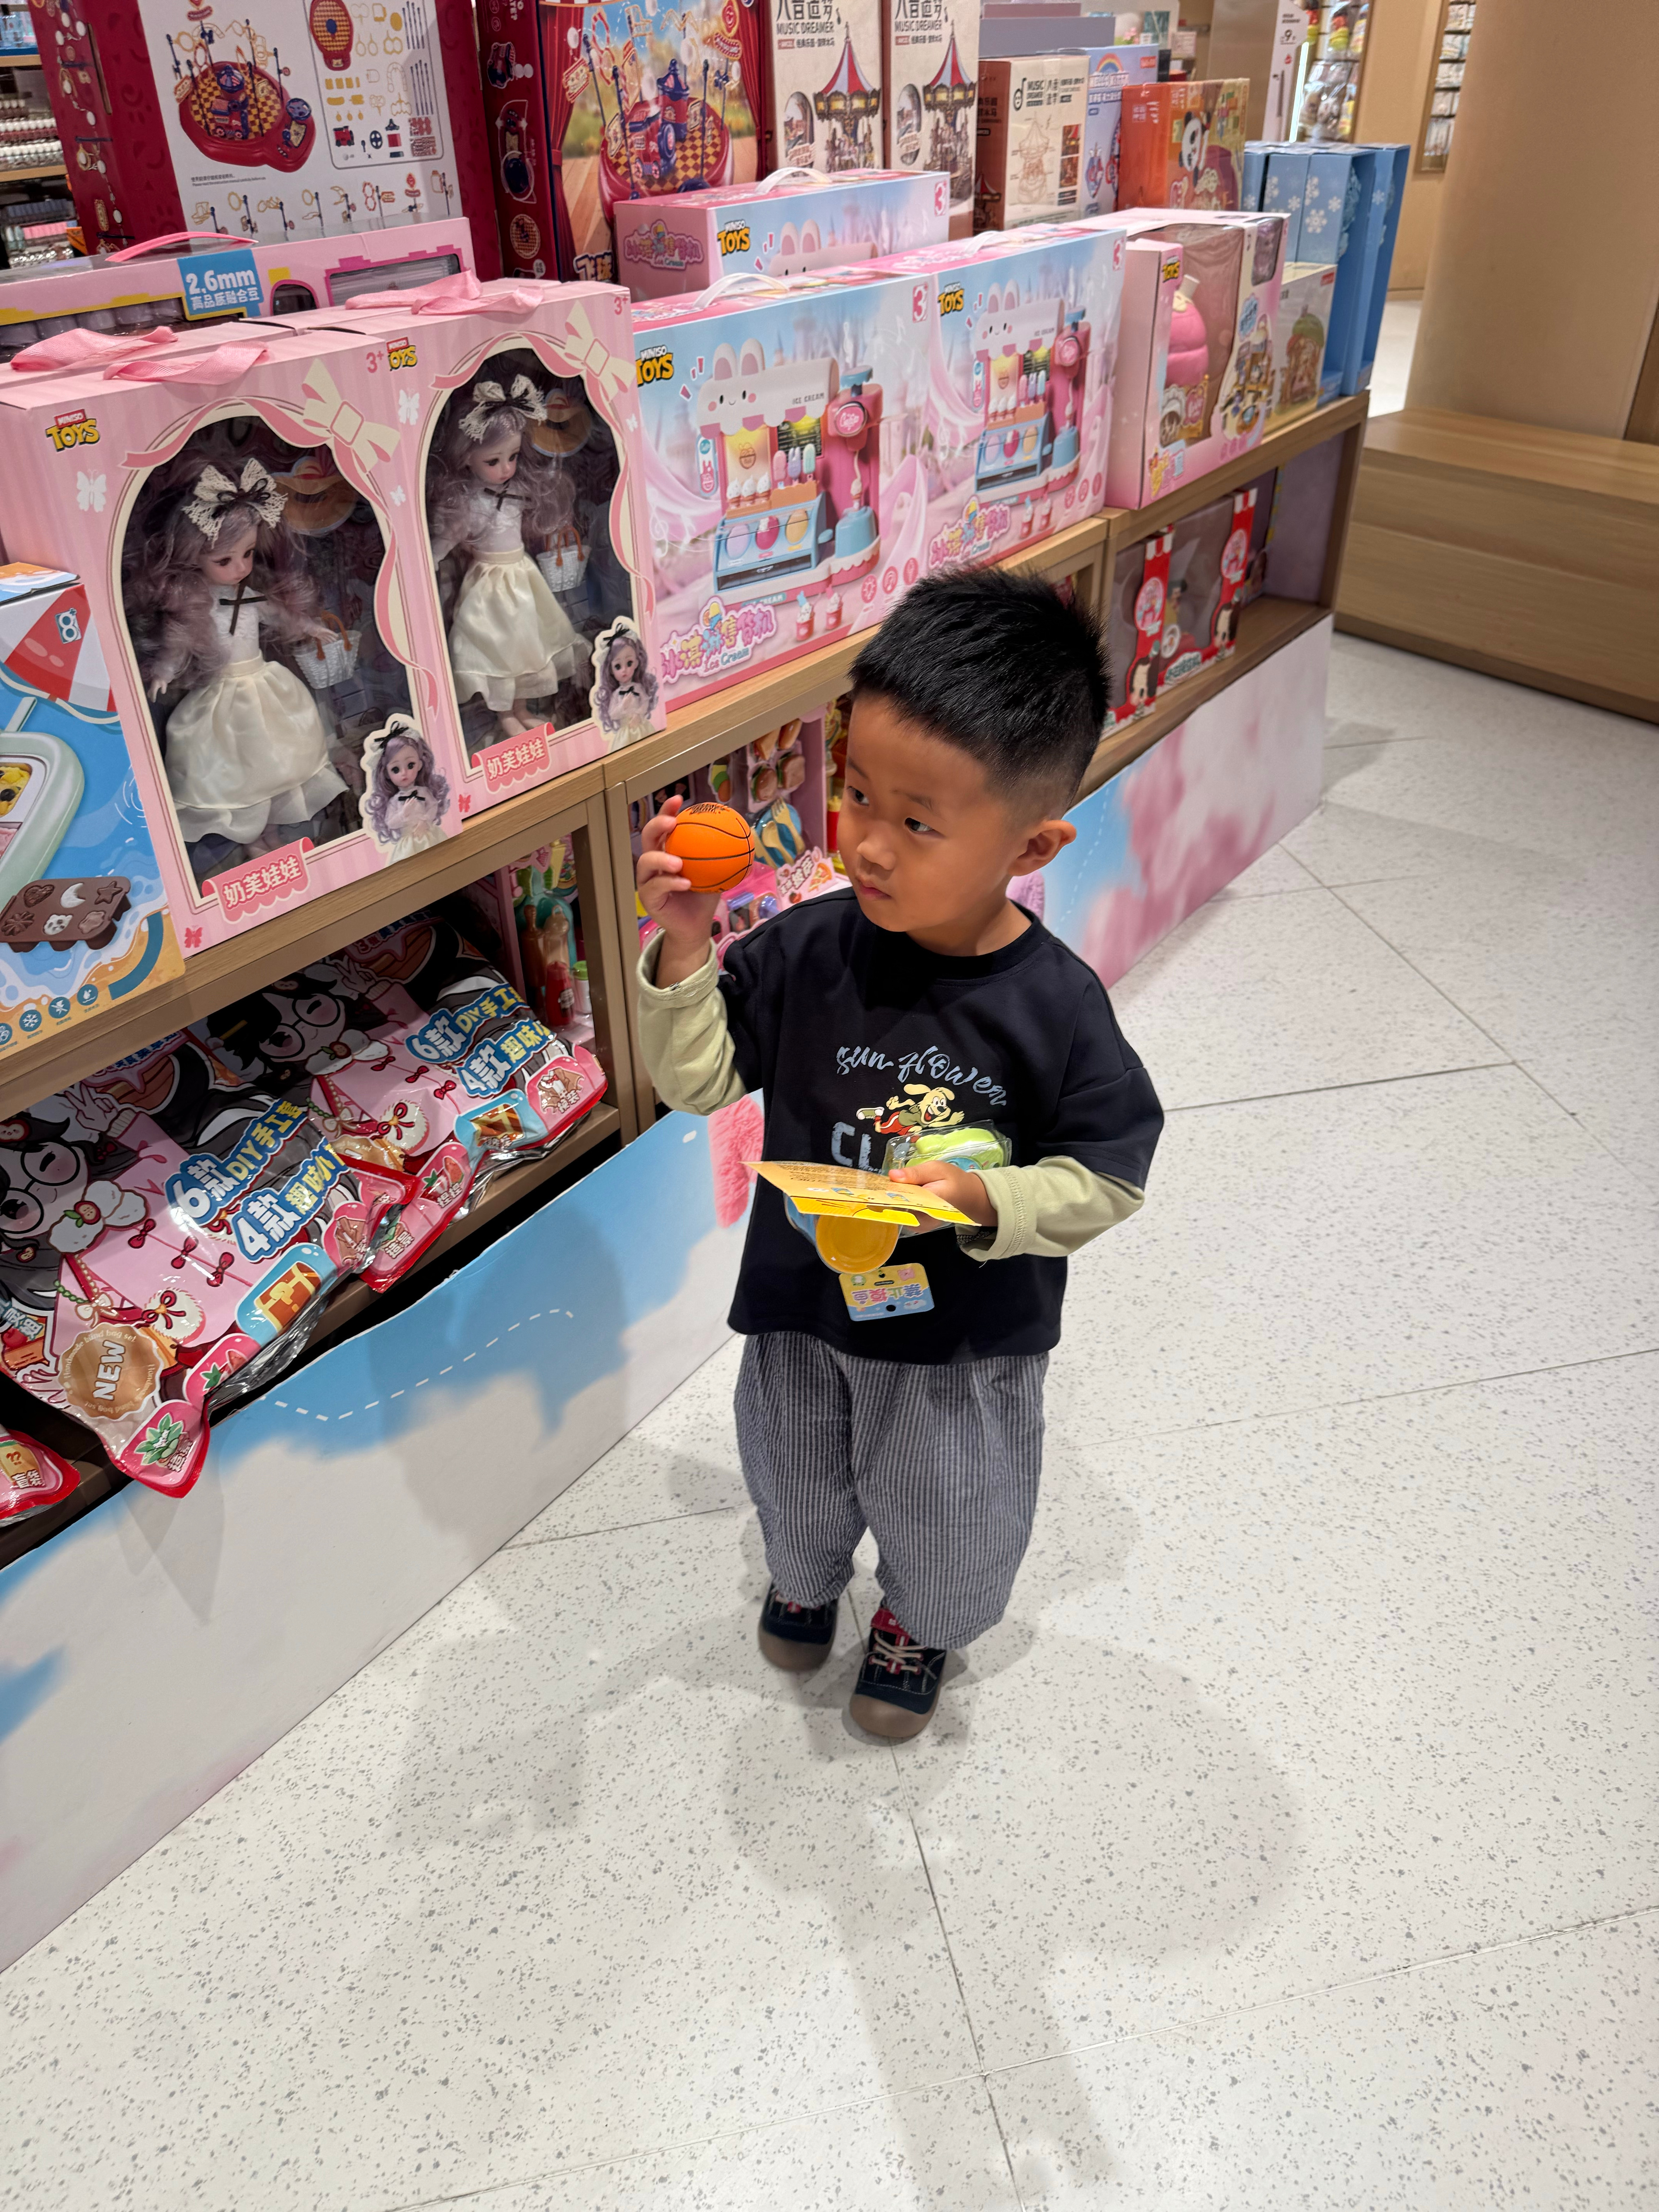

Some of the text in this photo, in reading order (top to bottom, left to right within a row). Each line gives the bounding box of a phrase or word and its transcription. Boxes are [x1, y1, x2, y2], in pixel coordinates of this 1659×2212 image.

[776, 22, 834, 34] MUSIC DREAMER
[1027, 80, 1044, 91] MUSIC
[724, 220, 745, 232] MINISO
[718, 227, 750, 256] TOYS
[186, 270, 256, 295] 2.6mm
[191, 287, 260, 310] 高品质融合豆
[615, 297, 629, 316] 3+
[938, 289, 965, 317] TOYS
[366, 351, 384, 374] 3+
[388, 345, 417, 371] OYS
[640, 345, 667, 361] MINISO
[635, 353, 674, 387] TOYS
[804, 393, 824, 402] CREAM
[58, 412, 84, 426] MINISO
[45, 419, 100, 452] TOYS
[721, 647, 749, 665] Cream
[487, 738, 546, 779] 奶芙娃娃
[223, 856, 302, 908] 奶芙娃娃
[436, 1182, 463, 1209] 捏捏
[851, 1283, 924, 1305] 禁止摸鱼
[64, 1329, 137, 1378] Handmade blind bag set
[93, 1340, 126, 1401] NEW
